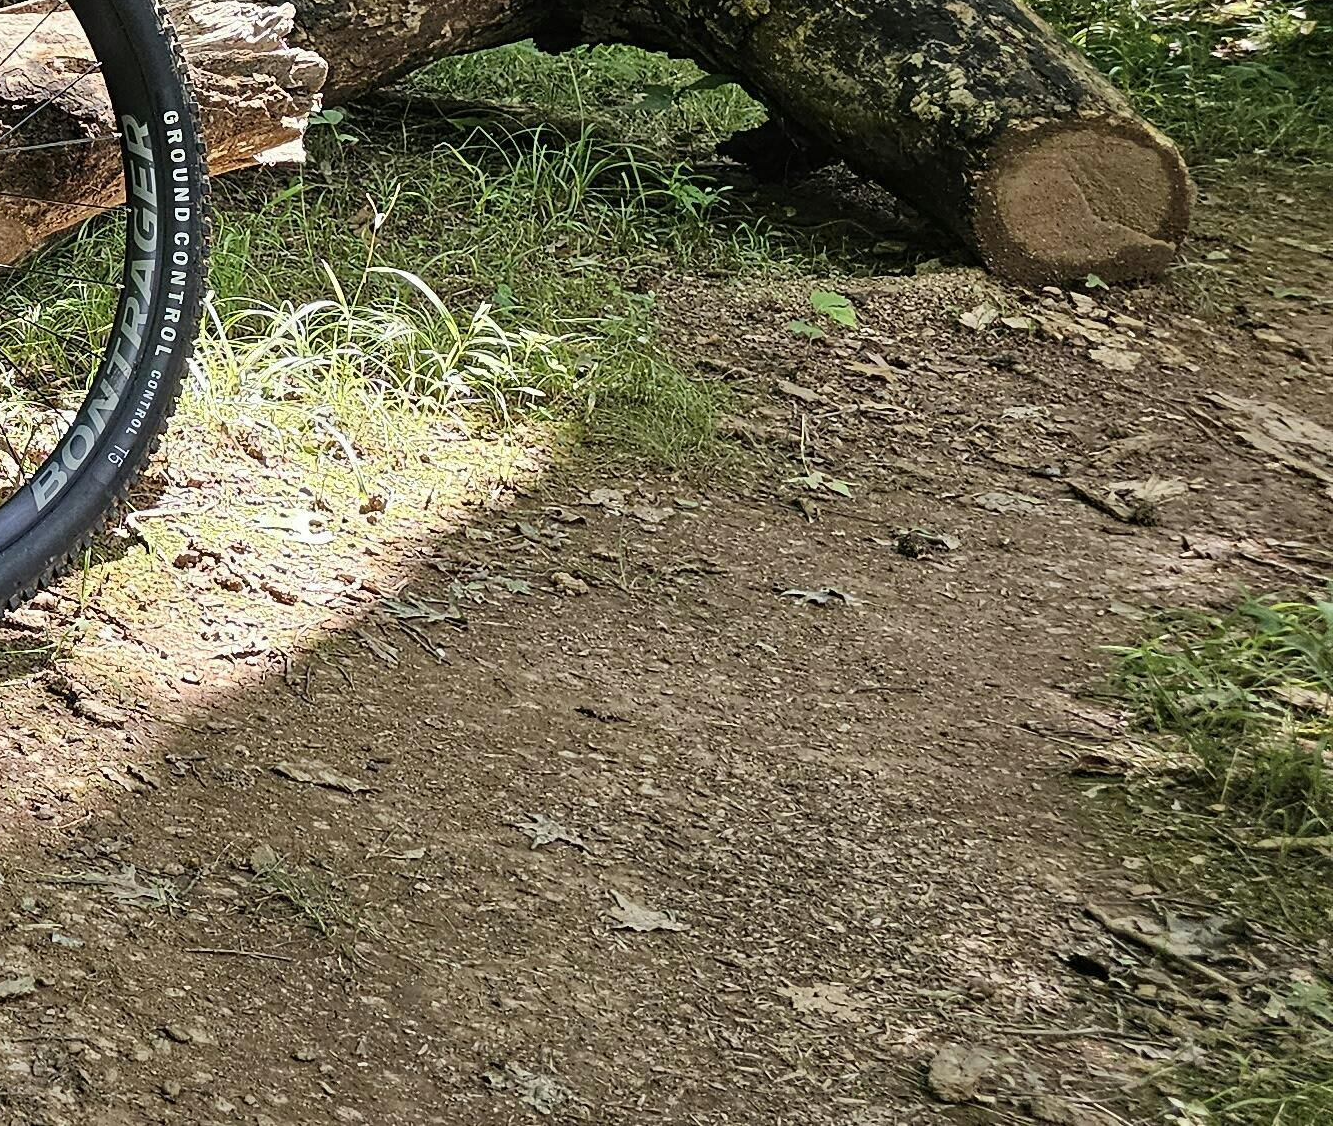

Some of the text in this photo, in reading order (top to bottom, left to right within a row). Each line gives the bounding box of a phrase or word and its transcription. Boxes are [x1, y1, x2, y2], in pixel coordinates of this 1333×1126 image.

[32, 113, 158, 512] BONTRAGER
[155, 110, 190, 356] GROUND CONTROL
[125, 370, 162, 436] CONTROL
